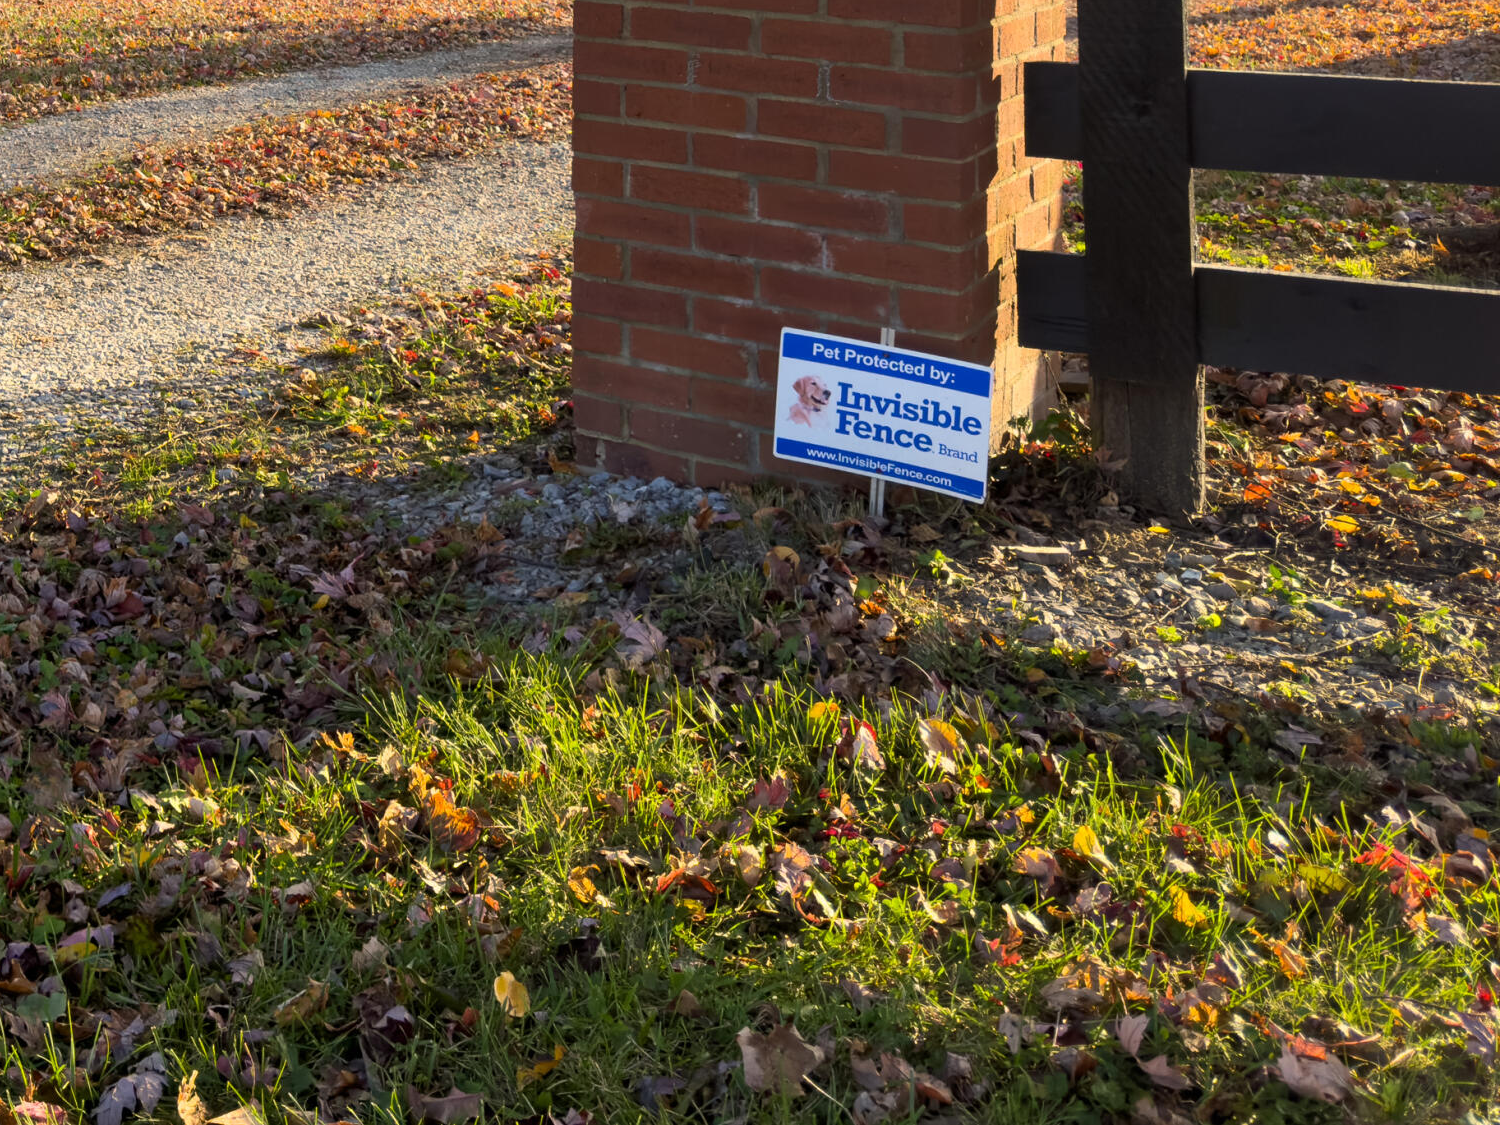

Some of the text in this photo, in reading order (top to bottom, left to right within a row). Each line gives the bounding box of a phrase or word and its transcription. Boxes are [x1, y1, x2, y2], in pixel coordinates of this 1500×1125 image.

[812, 342, 956, 385] Pet Protected by:
[836, 381, 983, 436] Invisible
[835, 409, 979, 464] Fence Brand
[806, 448, 952, 487] www.InvisibleFence.com
